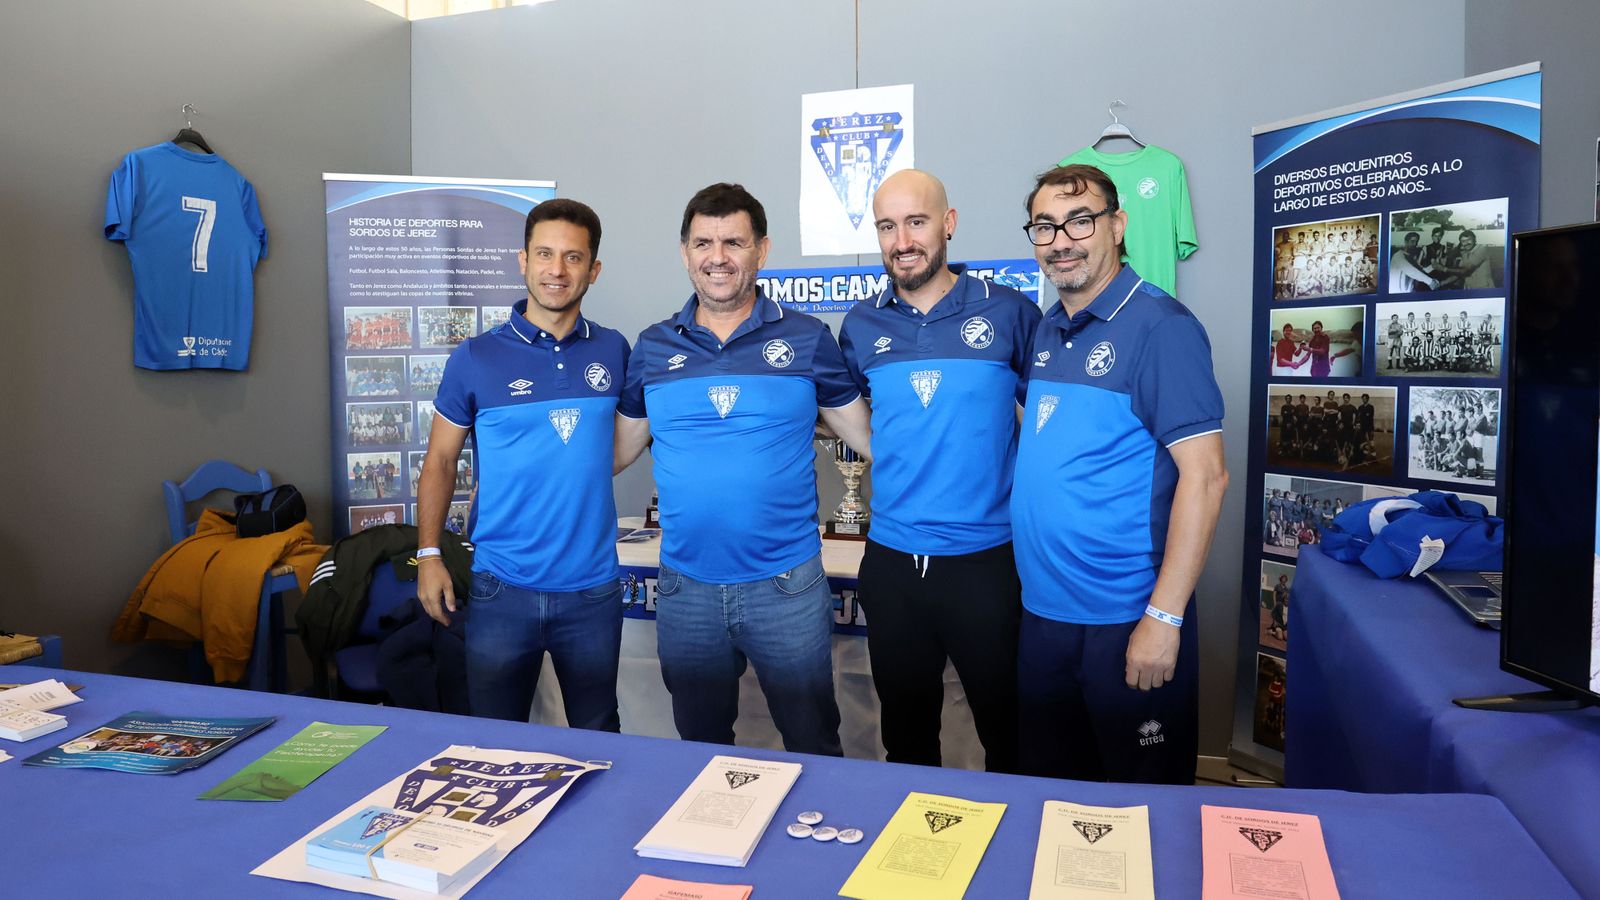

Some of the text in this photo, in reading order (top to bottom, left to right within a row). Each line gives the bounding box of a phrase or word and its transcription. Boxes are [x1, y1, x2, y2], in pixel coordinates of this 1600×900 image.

[829, 114, 884, 128] JEREZ
[841, 132, 871, 141] CLUB
[1274, 151, 1413, 186] DIVERSOS ENCUENTROS
[1274, 158, 1463, 199] DEPORTIVOS CELEBRADOS A LO
[1273, 180, 1432, 213] LARGO DE ESTOS 50 AÑOS...
[348, 217, 484, 229] HISTORIA DE DEPORTES PARA
[181, 195, 217, 273] 7
[349, 227, 438, 238] SORDOS DE JEREZ
[510, 389, 532, 397] umbro
[1139, 733, 1165, 747] errea
[460, 760, 556, 775] JEREZ
[465, 778, 516, 789] CLUB
